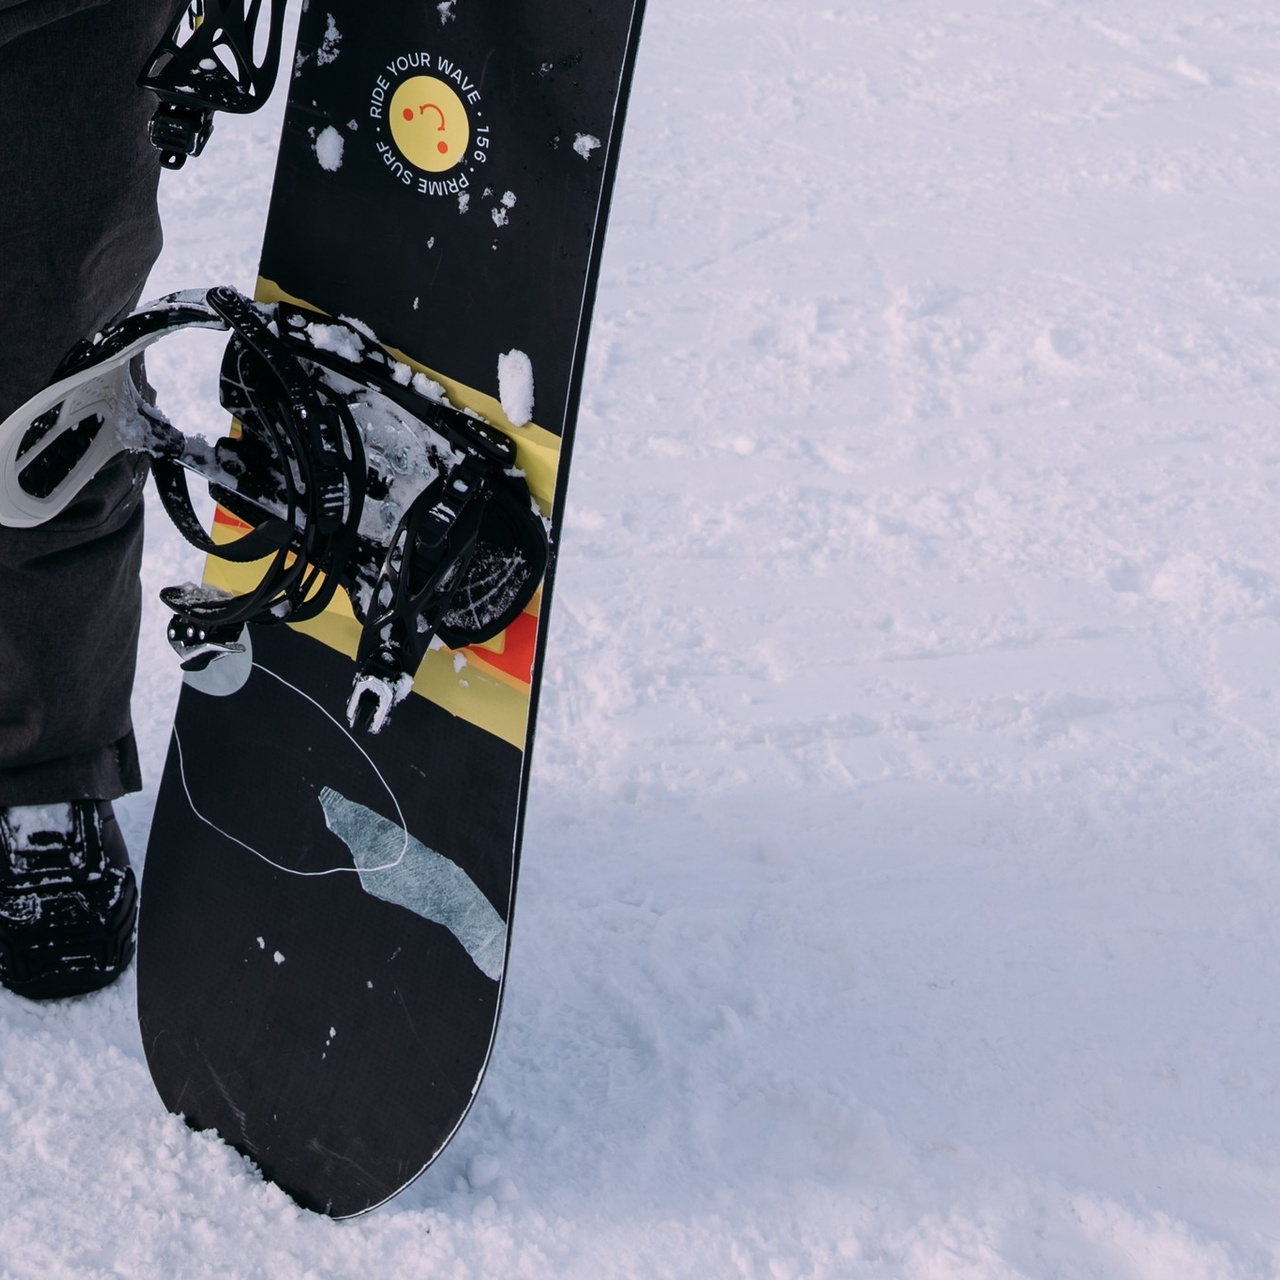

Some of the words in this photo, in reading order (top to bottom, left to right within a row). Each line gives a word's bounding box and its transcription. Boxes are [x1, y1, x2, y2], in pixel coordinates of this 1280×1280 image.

[386, 52, 431, 76] YOUR
[437, 56, 481, 105] WAVE
[370, 75, 390, 119] RIDE
[376, 141, 413, 185] SURF
[473, 126, 489, 163] 156
[417, 172, 470, 196] PRIME
